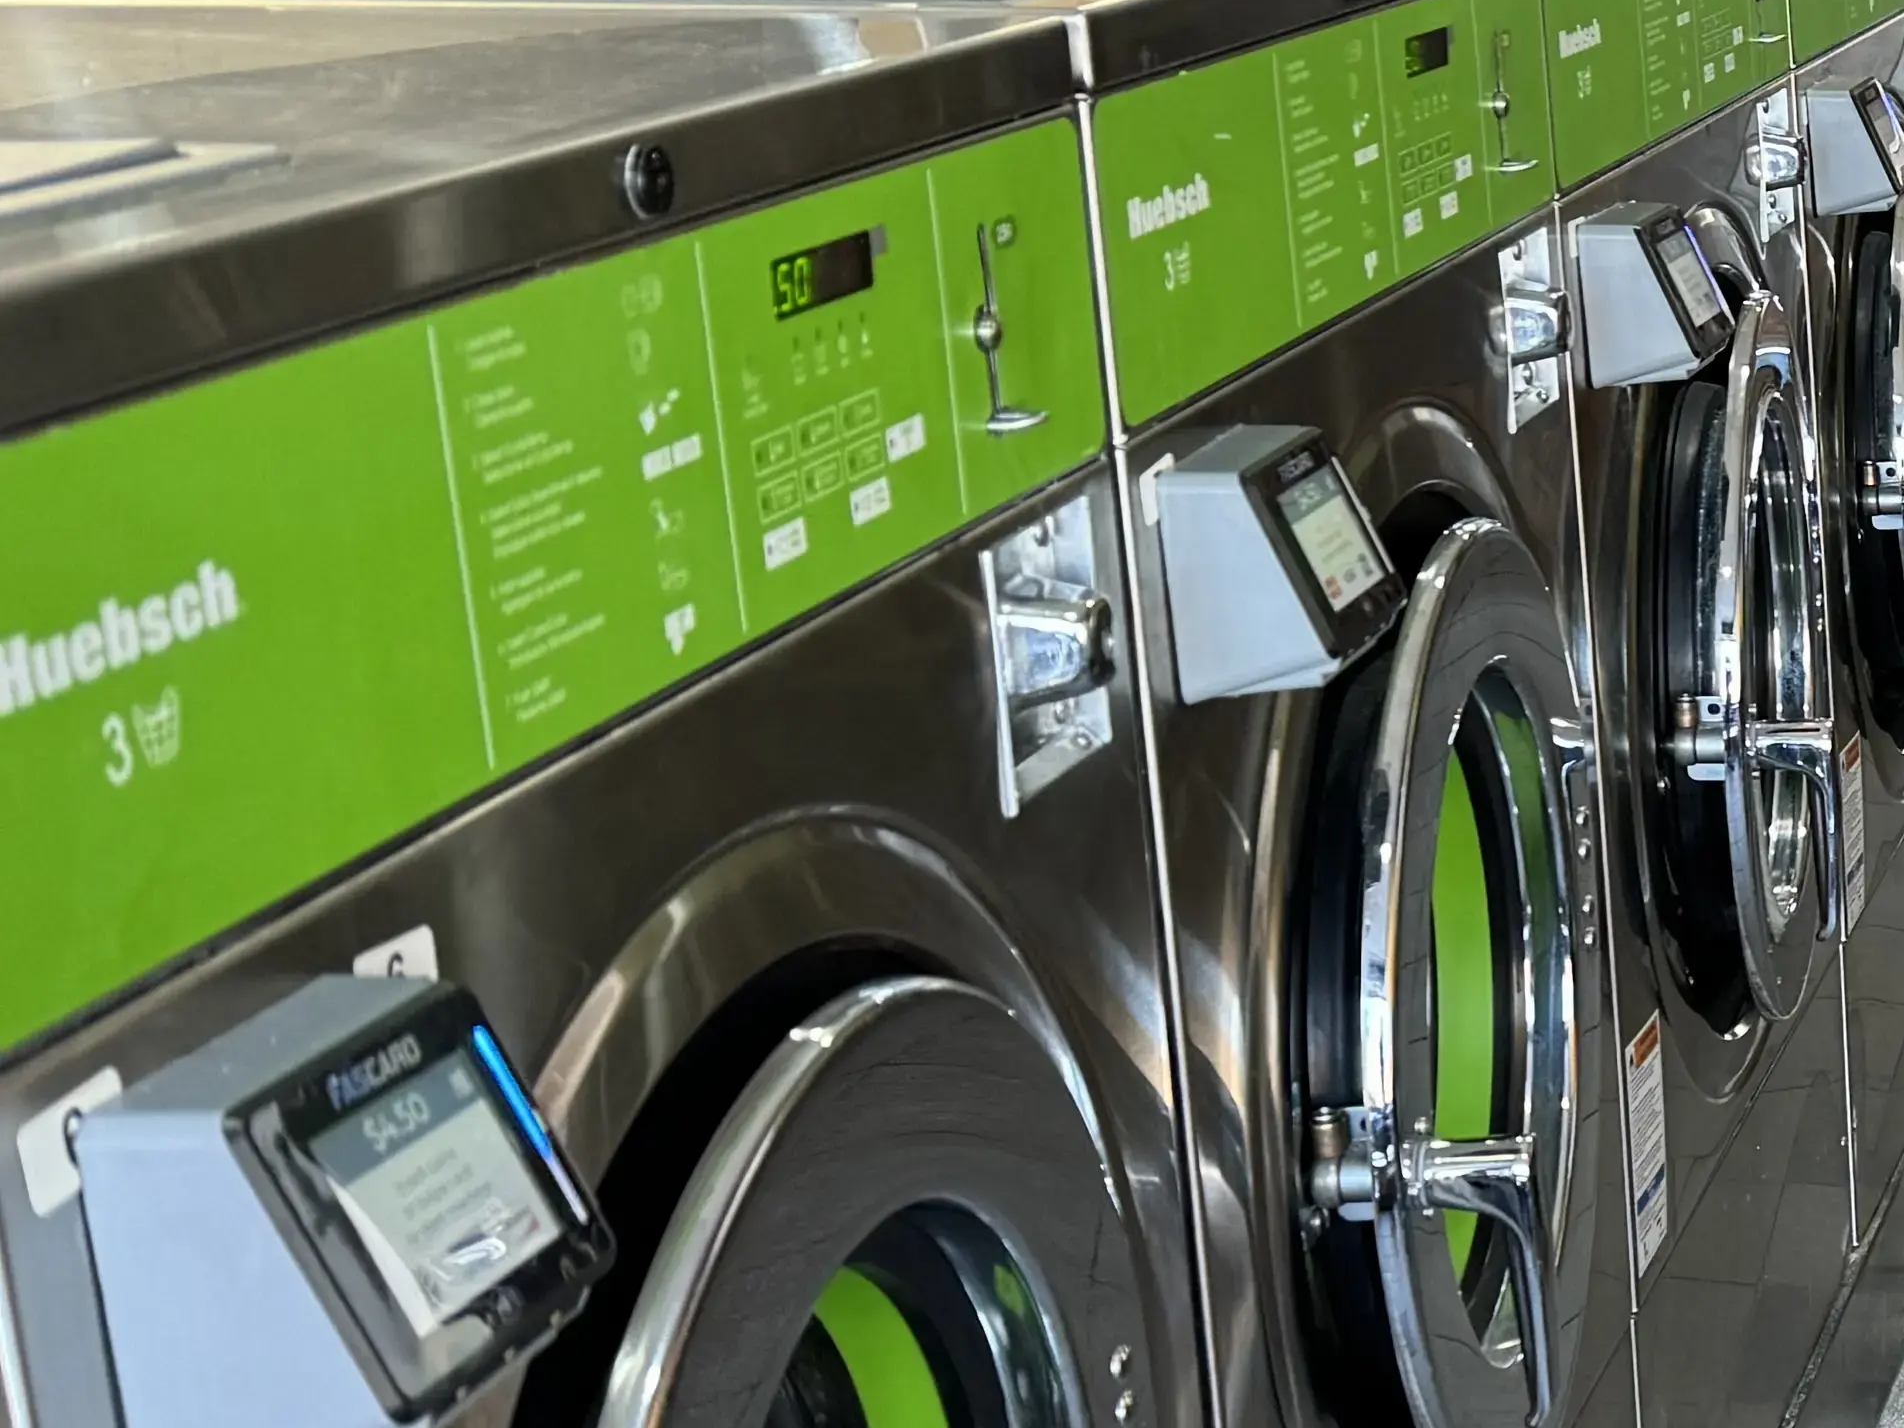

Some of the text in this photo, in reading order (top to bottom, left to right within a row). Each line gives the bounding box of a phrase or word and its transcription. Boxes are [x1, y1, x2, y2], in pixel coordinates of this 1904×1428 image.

[1127, 173, 1211, 240] Huebsch
[1164, 250, 1175, 291] 3
[0, 558, 239, 718] Huebsch
[102, 712, 134, 788] 3
